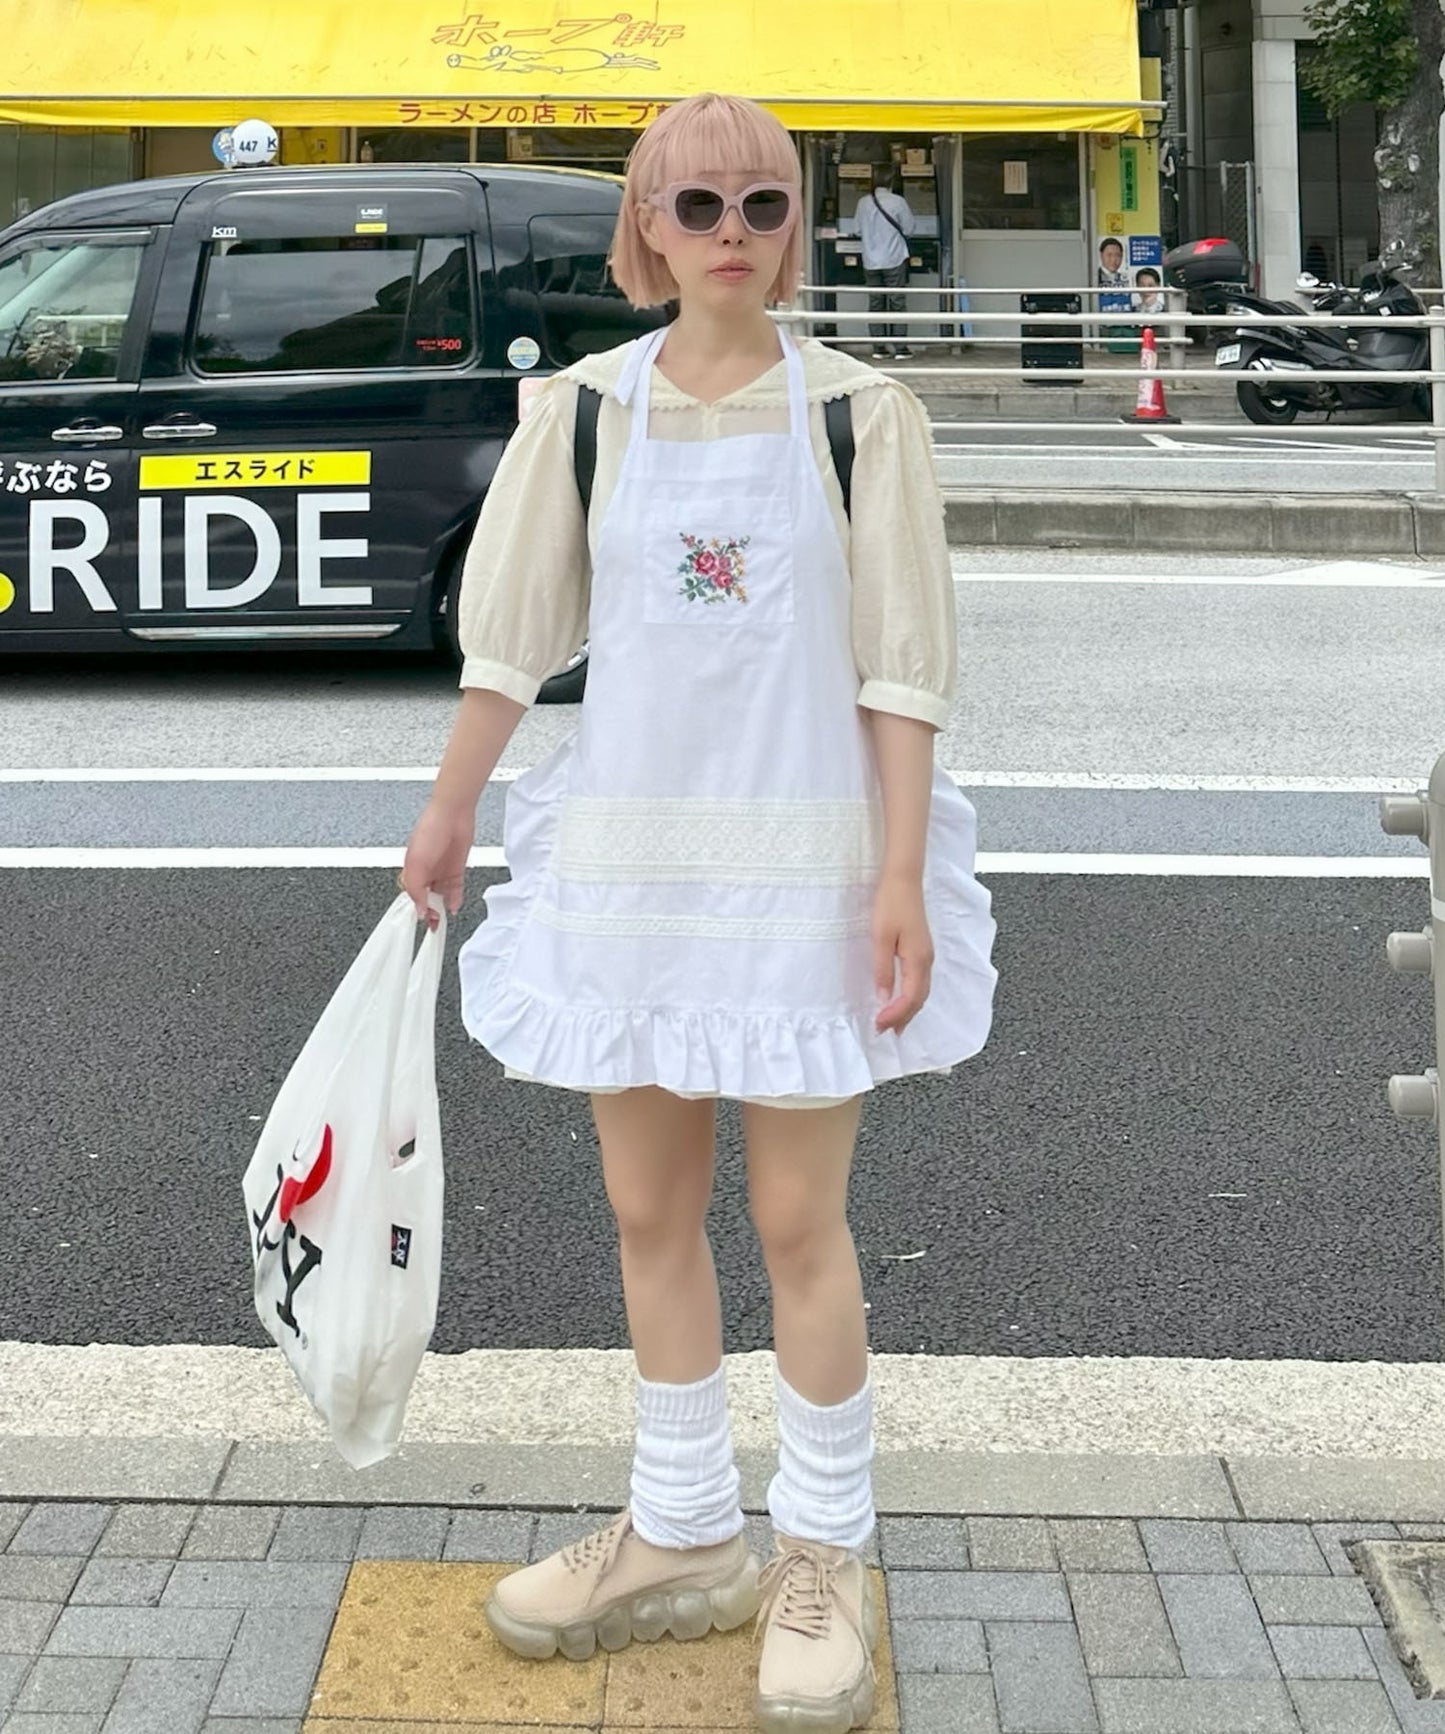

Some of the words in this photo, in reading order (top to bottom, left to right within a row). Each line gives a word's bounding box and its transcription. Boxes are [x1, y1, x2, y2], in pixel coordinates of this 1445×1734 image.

[431, 14, 686, 47] ホープ軒
[399, 103, 556, 124] ラーメンの店
[573, 103, 662, 125] ホープ
[239, 140, 259, 152] 447
[0, 459, 112, 493] ぶなら
[195, 459, 315, 480] エスライド
